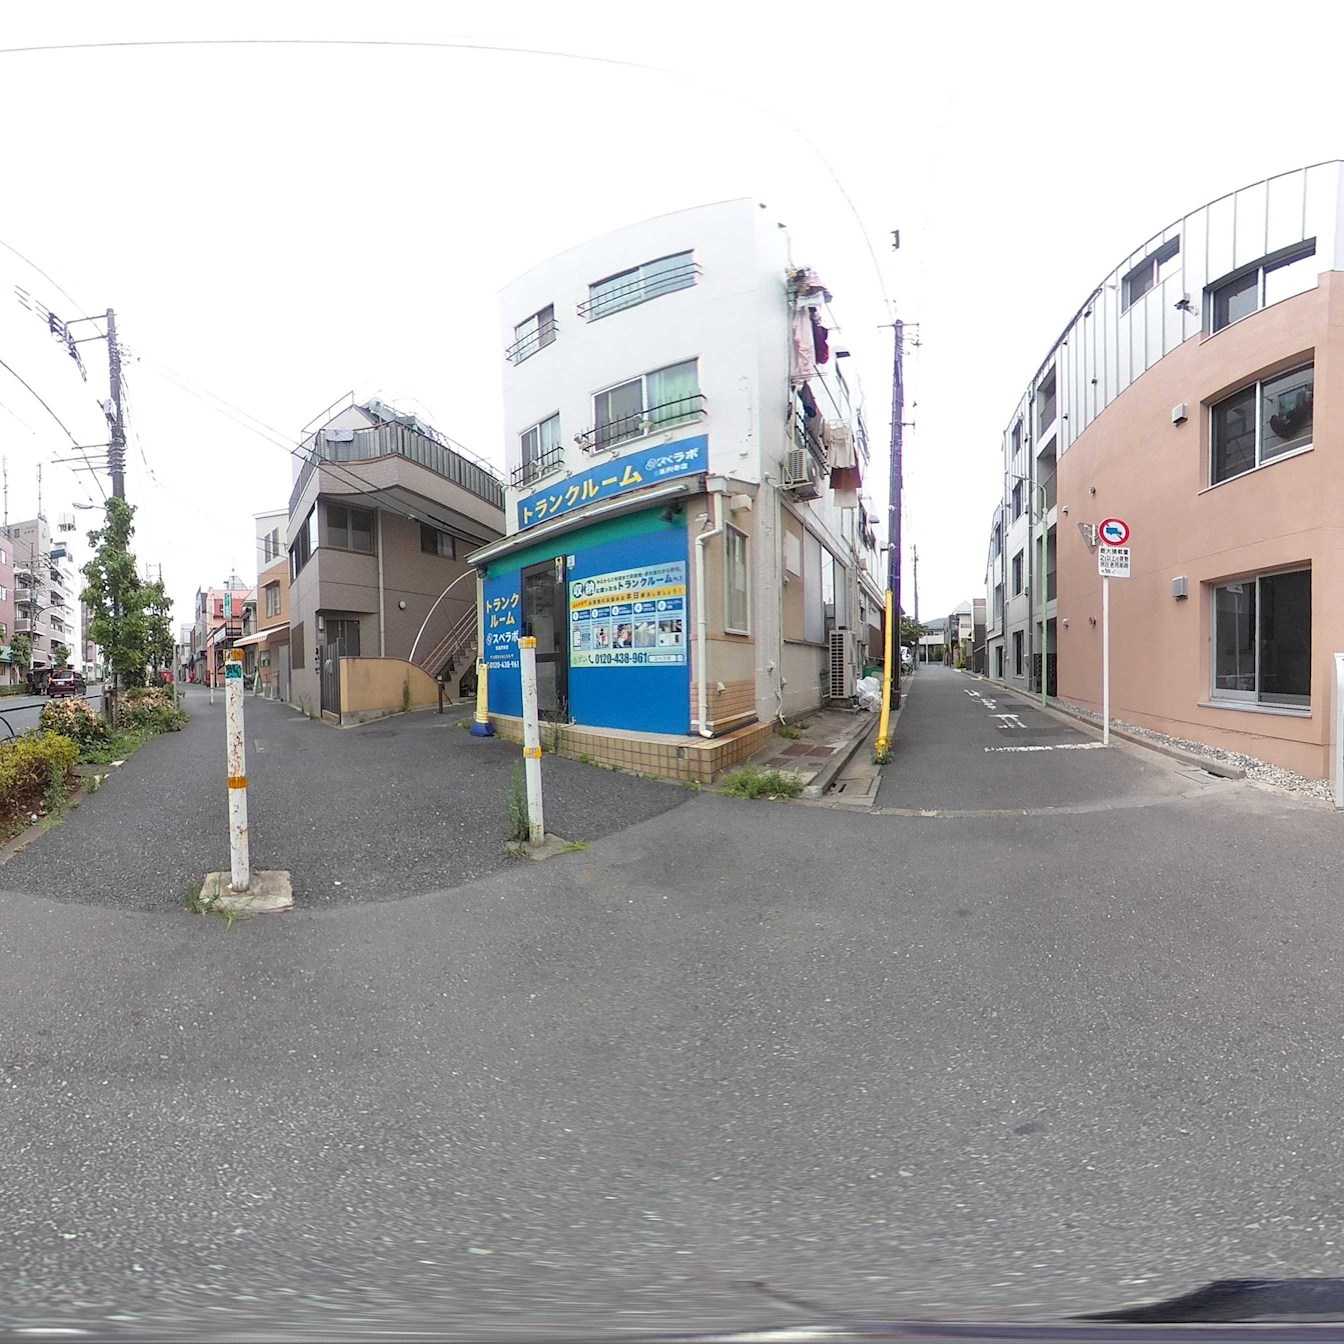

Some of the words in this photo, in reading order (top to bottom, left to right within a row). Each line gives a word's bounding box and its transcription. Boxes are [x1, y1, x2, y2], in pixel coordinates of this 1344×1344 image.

[523, 465, 643, 524] トランクルーム
[486, 592, 520, 614] トランク
[490, 611, 516, 628] ルーム
[492, 630, 519, 644] スペラボ
[595, 652, 648, 664] 0120-438-961
